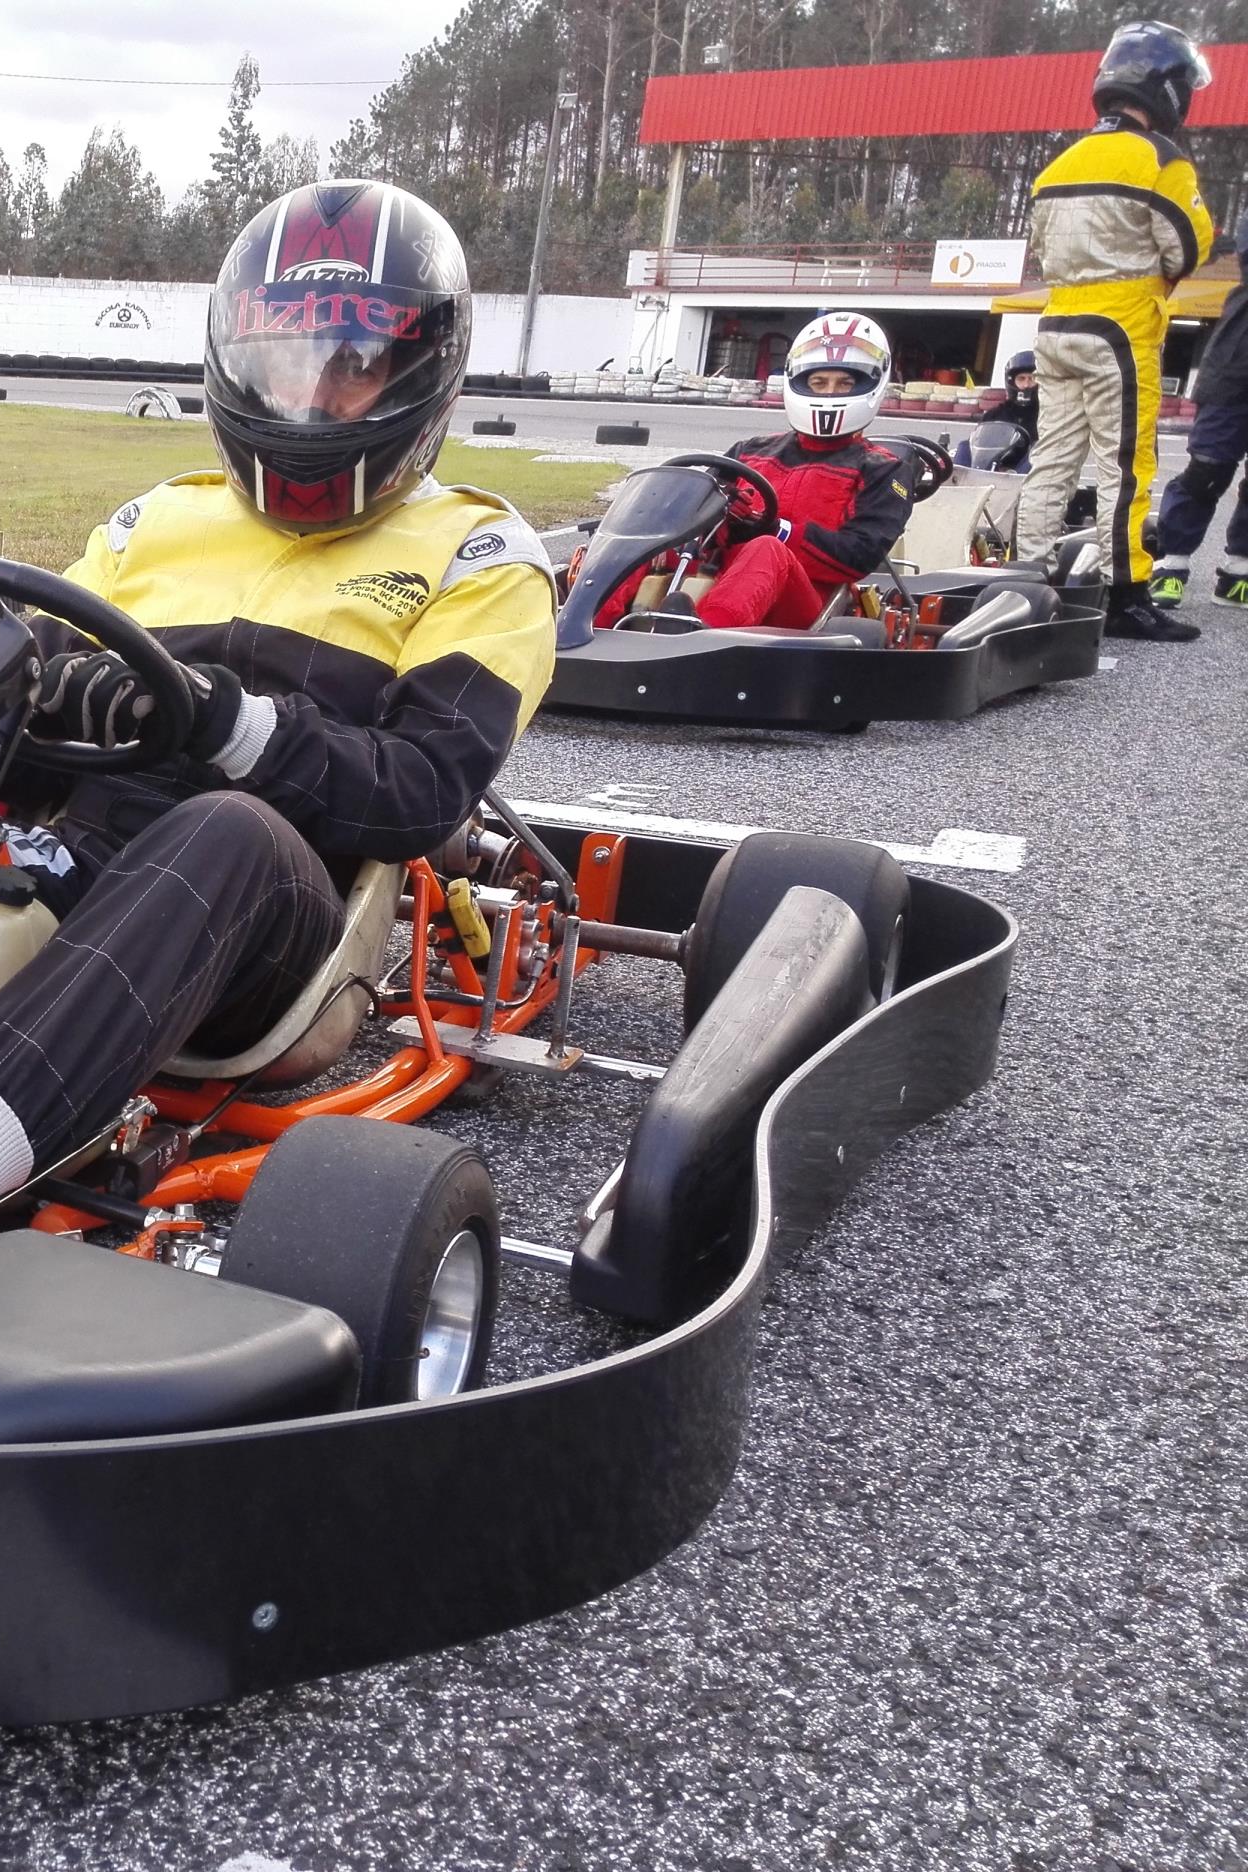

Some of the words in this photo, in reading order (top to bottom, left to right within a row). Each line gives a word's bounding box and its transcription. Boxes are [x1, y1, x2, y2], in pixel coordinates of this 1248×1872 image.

[95, 303, 120, 326] ESCOLA
[125, 302, 151, 330] KARTING
[368, 576, 428, 606] KARTING
